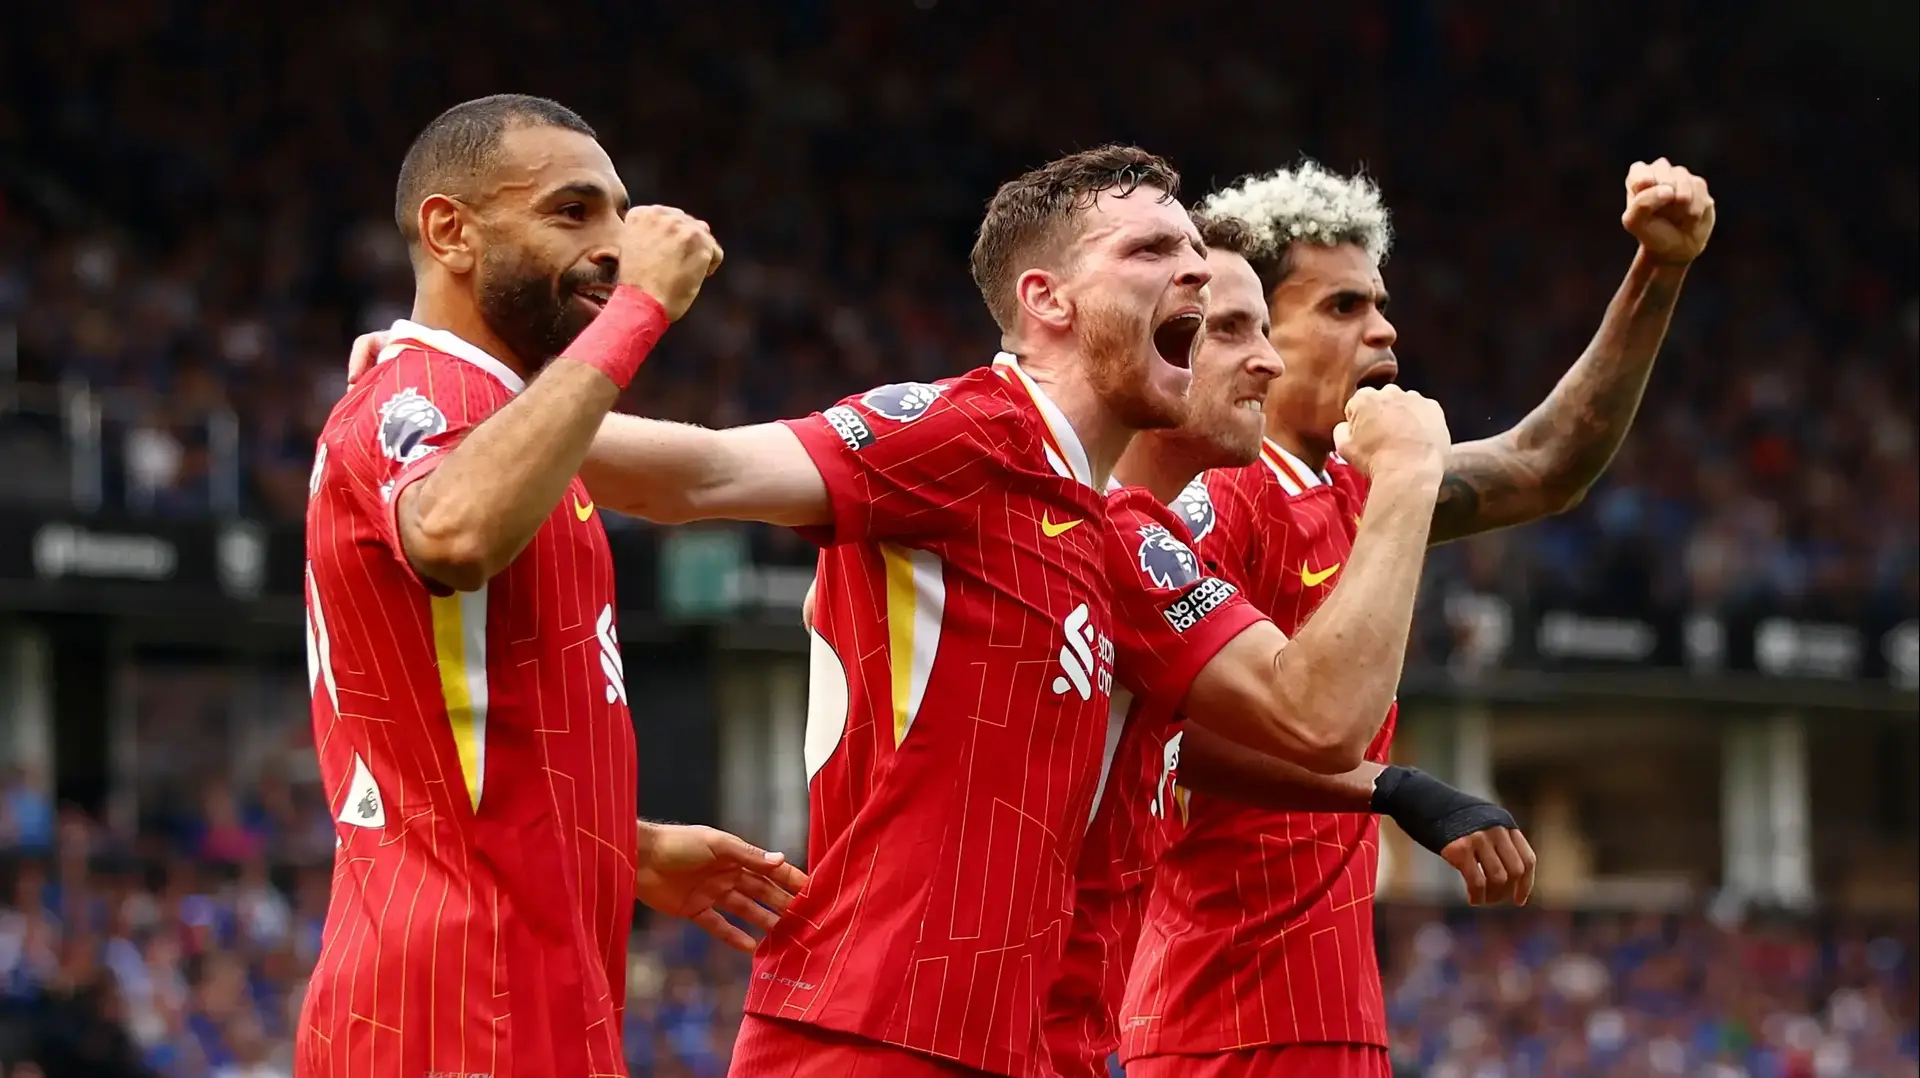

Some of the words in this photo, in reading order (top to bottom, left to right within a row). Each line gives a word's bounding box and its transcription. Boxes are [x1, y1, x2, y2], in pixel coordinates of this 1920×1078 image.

[1163, 600, 1190, 624] No
[1187, 577, 1225, 606] room
[1173, 610, 1197, 633] for
